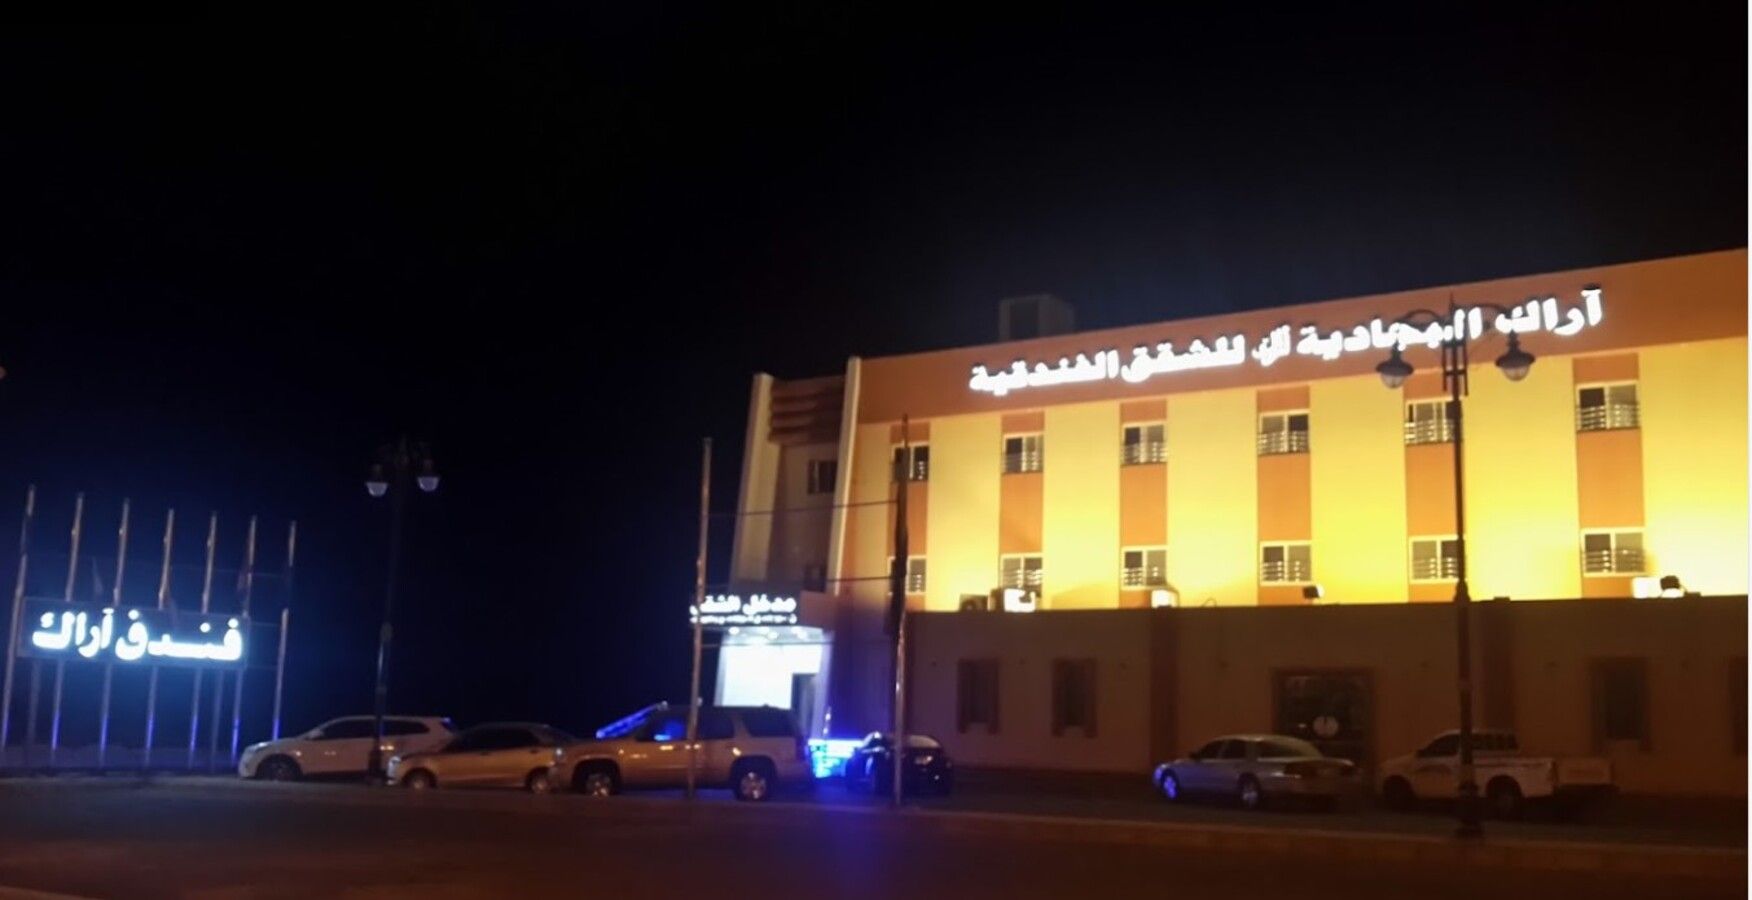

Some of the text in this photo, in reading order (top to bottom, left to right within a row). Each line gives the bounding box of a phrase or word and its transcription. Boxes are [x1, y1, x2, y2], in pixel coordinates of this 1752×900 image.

[1494, 289, 1603, 336] آراك
[968, 349, 1119, 396] الفندقية
[1121, 334, 1246, 384] للشقق
[742, 594, 797, 615] مدخل
[32, 607, 243, 661] فندق آراك
